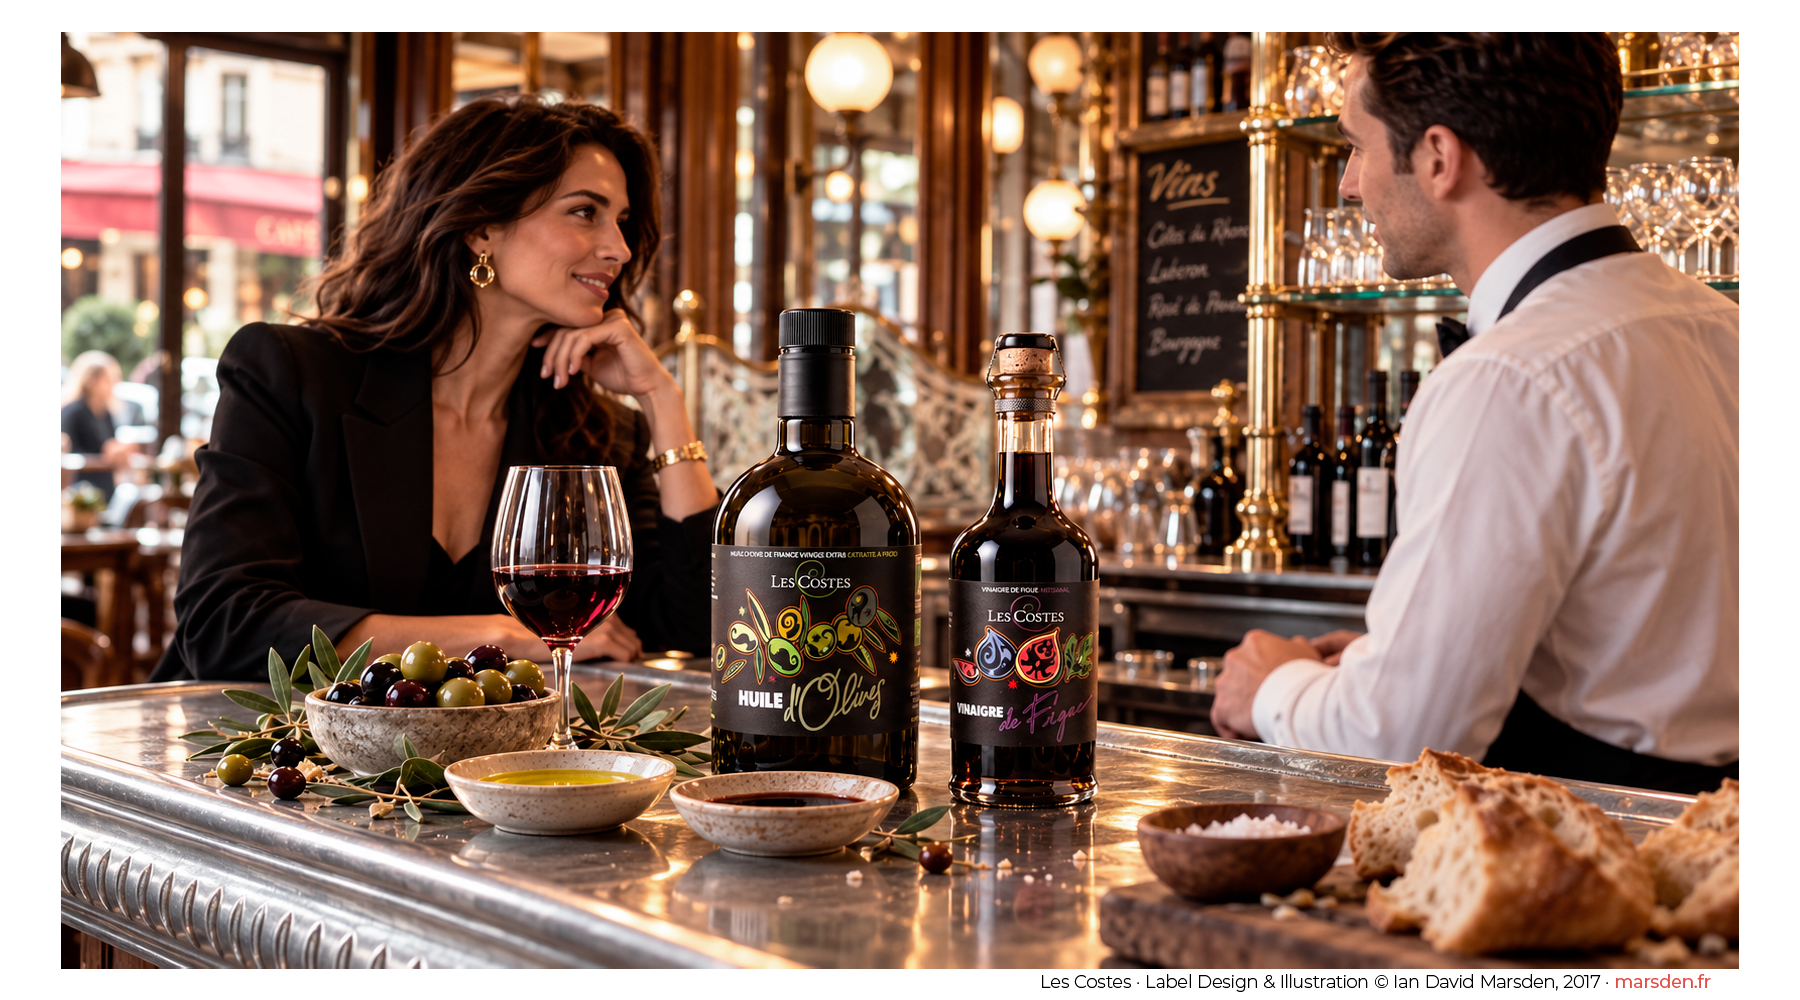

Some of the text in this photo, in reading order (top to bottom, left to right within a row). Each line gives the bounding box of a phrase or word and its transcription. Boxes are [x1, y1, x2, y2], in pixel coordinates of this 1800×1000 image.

[1147, 159, 1219, 201] Vins
[771, 575, 851, 589] LES COSTES
[988, 609, 1065, 623] LES COSTES
[738, 689, 783, 709] HUILE
[957, 702, 1004, 718] VINAIGRE
[999, 706, 1022, 732] de
